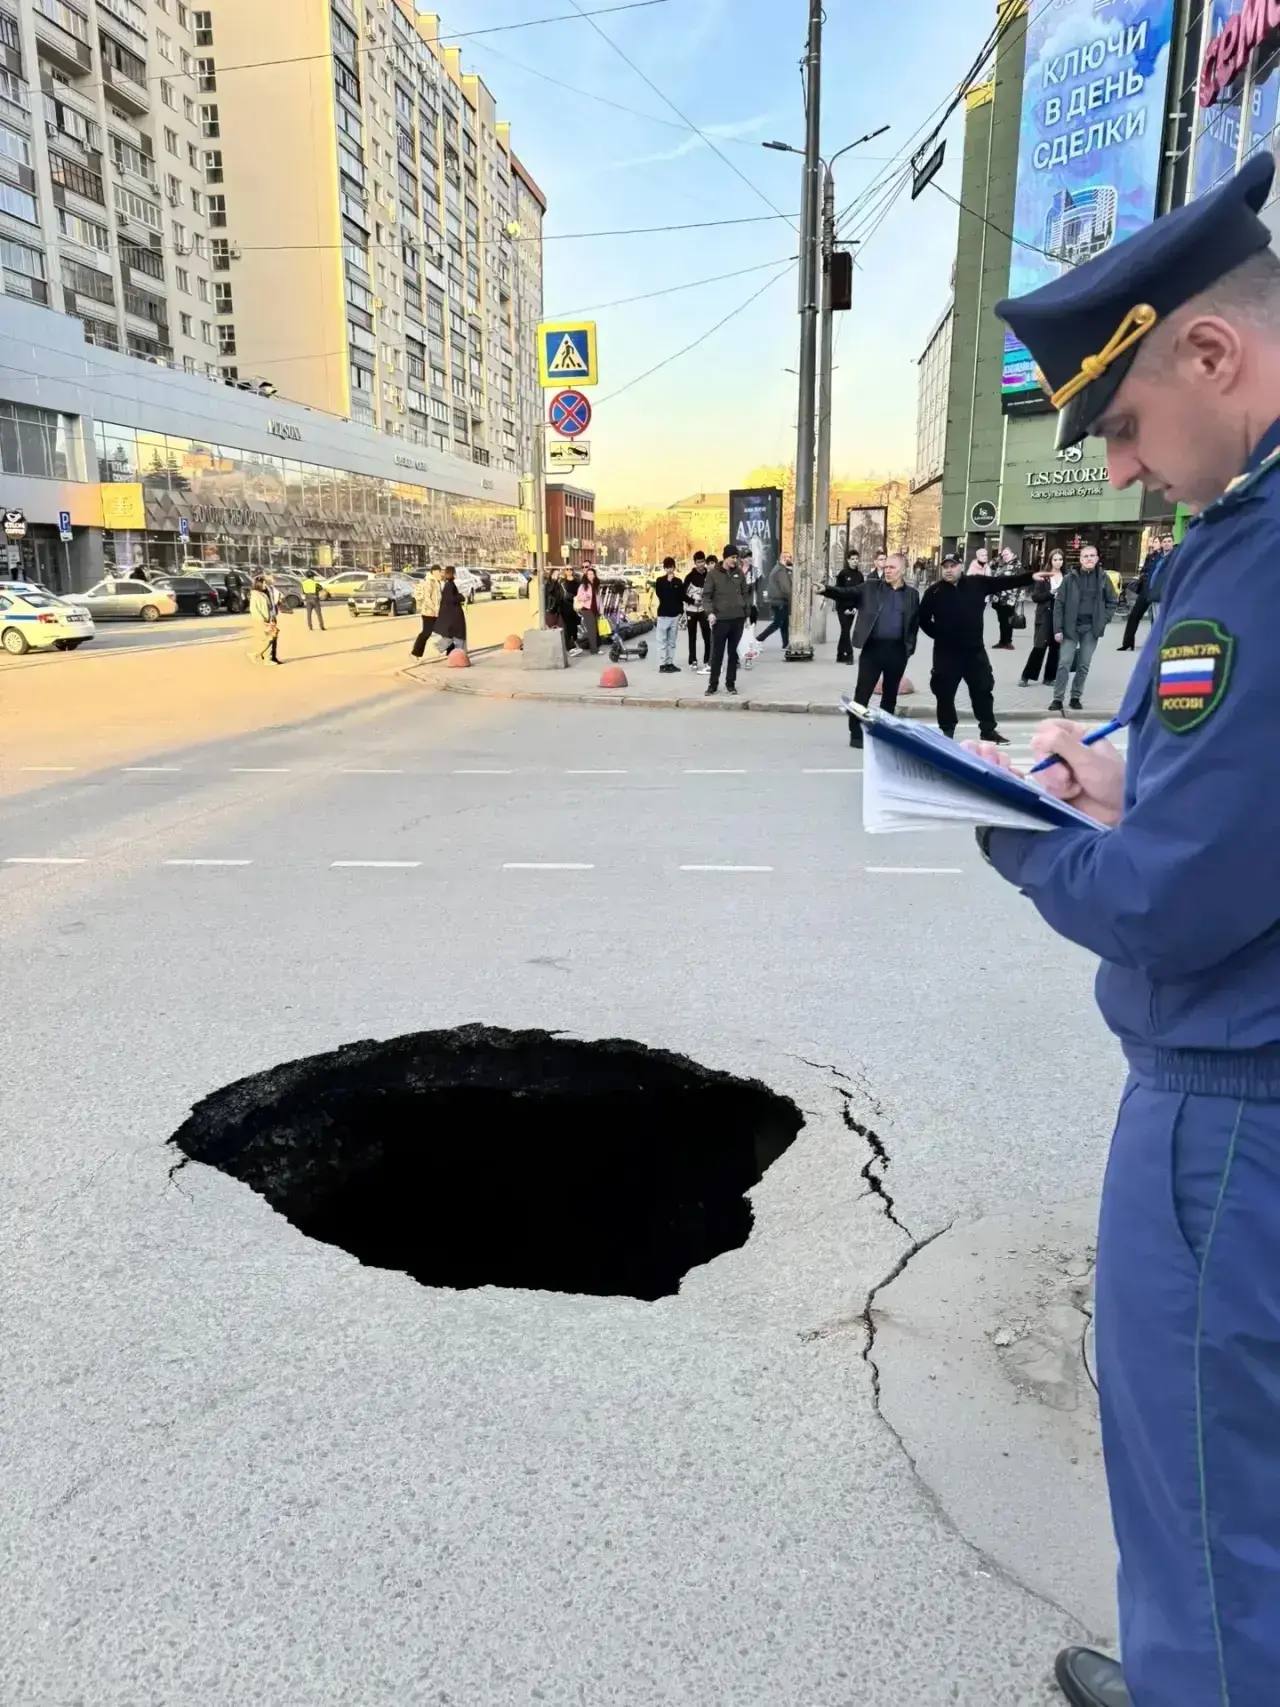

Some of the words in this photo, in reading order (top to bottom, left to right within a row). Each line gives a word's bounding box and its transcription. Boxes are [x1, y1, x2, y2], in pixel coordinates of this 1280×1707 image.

[1042, 20, 1148, 88] КЛЮЧИ
[1045, 98, 1062, 126] В
[1066, 67, 1144, 121] ДЕНЬ
[1033, 108, 1146, 169] СДЕЛКИ
[1053, 467, 1109, 484] STORE
[61, 513, 69, 530] P
